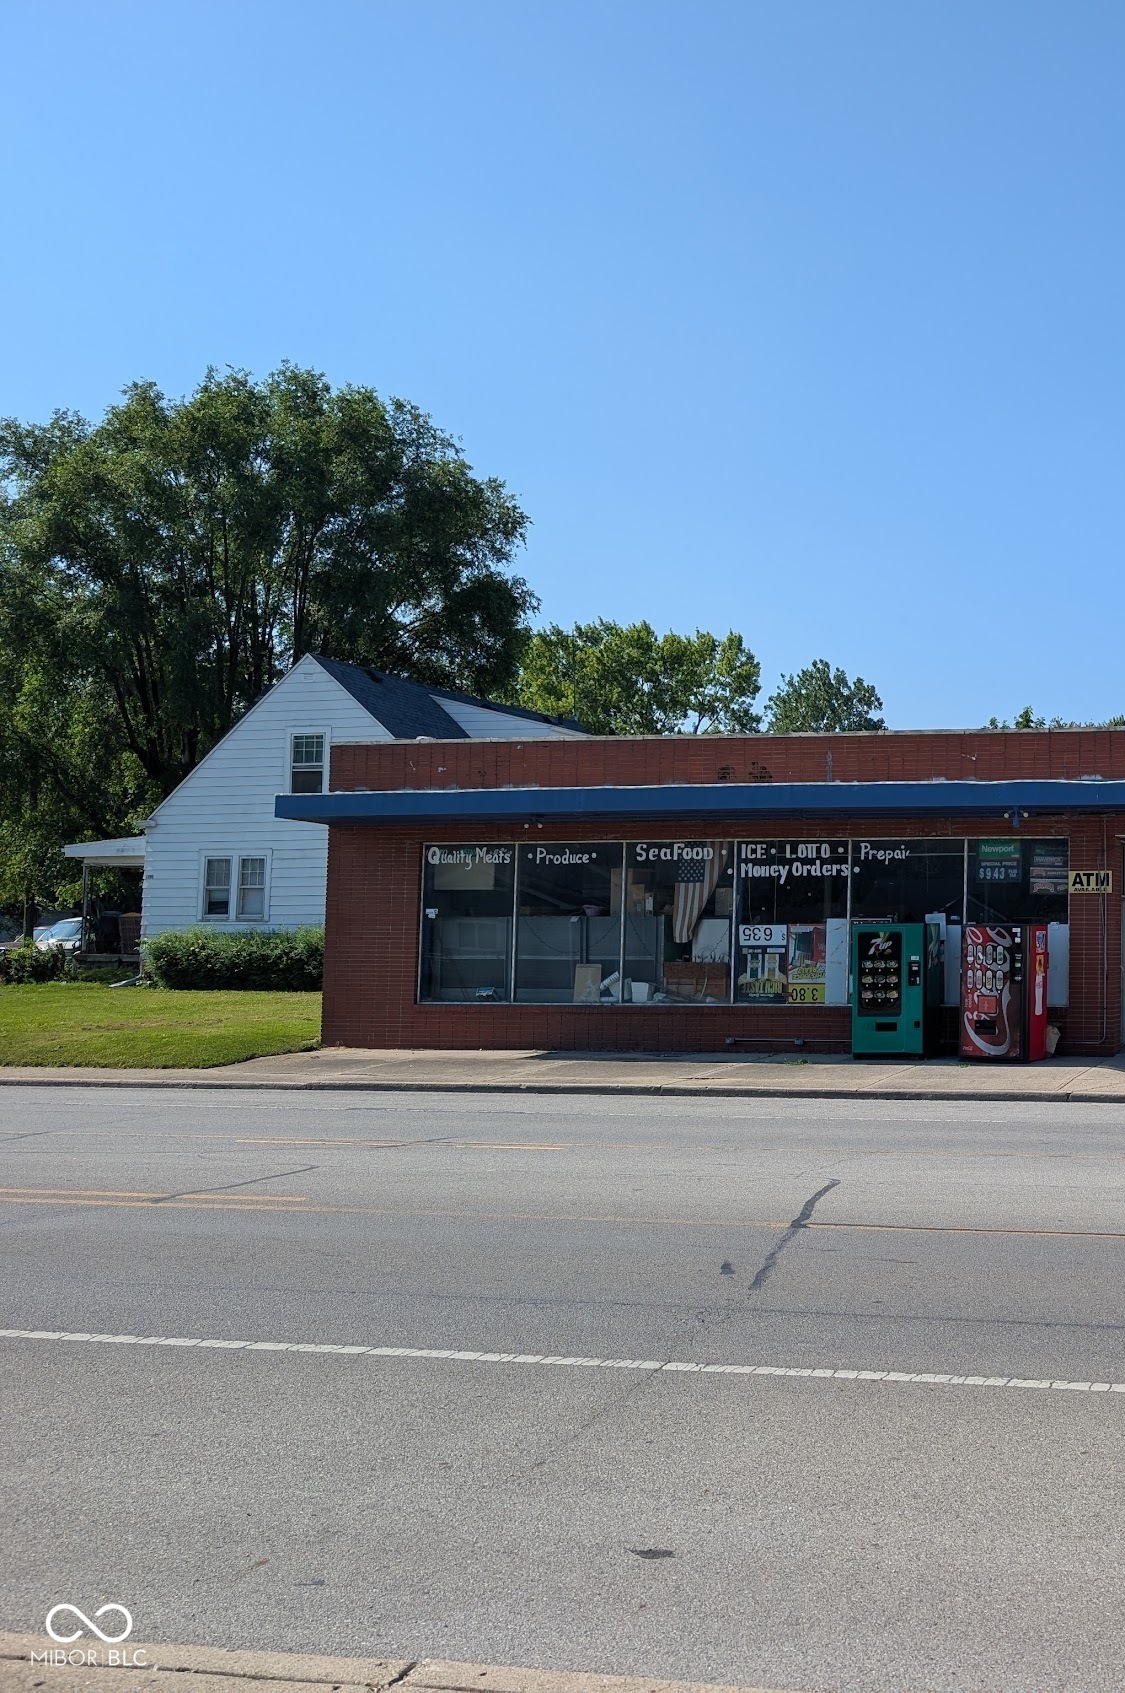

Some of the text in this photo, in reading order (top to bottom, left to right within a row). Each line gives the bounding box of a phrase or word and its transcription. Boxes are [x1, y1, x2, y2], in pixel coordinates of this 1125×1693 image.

[536, 848, 590, 864] Produce
[741, 843, 831, 859] ICE LOTTO
[981, 845, 1014, 853] Newport
[428, 846, 511, 870] Quality Meats
[740, 859, 850, 884] Money Orders
[1072, 872, 1110, 886] ATM
